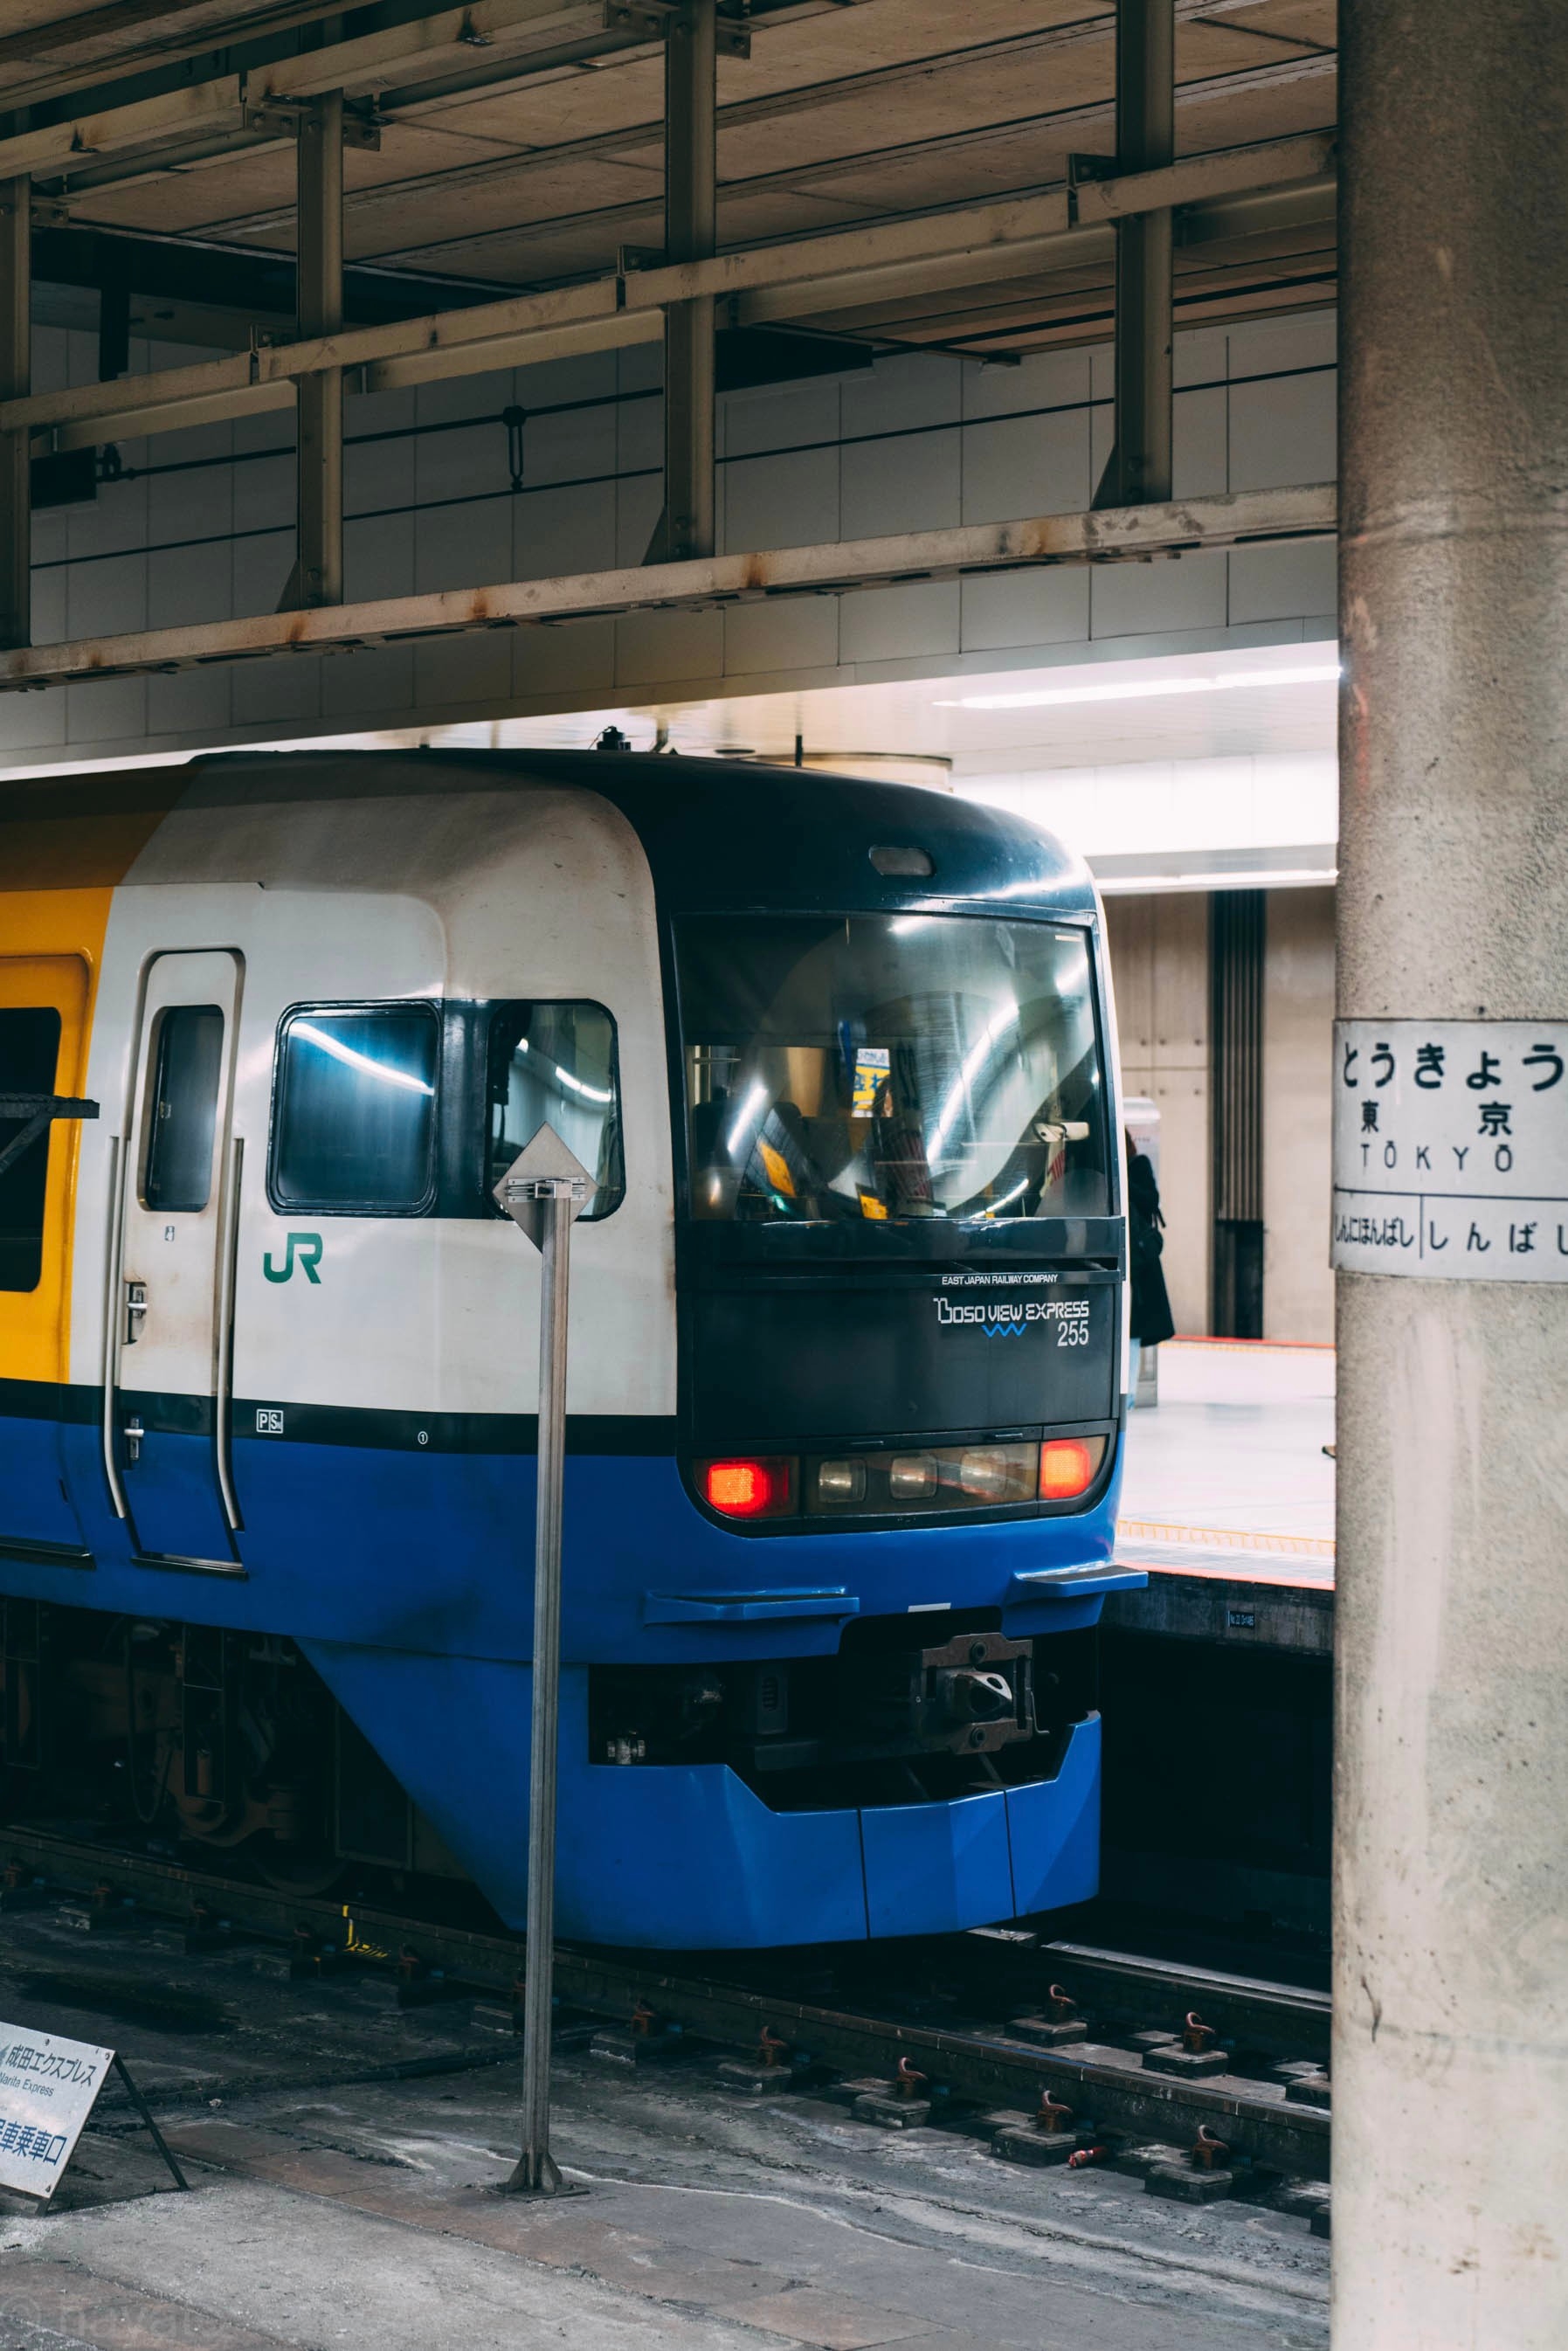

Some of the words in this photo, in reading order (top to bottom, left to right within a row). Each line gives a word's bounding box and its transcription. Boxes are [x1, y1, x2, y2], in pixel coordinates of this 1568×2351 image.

[1343, 1041, 1565, 1092] とうきょう
[1360, 1100, 1513, 1137] 東京
[1360, 1140, 1513, 1172] TŌKYŌ
[263, 1232, 323, 1284] JR
[942, 1276, 964, 1285] EAST
[964, 1276, 991, 1285] JAPAN
[991, 1275, 1022, 1284] RAILWAY
[1023, 1274, 1059, 1283] COMPANY
[988, 1303, 1023, 1322] VIEW
[1026, 1300, 1089, 1320] EXPRESS
[1057, 1320, 1089, 1346] 255
[5, 2044, 97, 2086] 成田エクスプレス
[22, 2078, 54, 2097] Express
